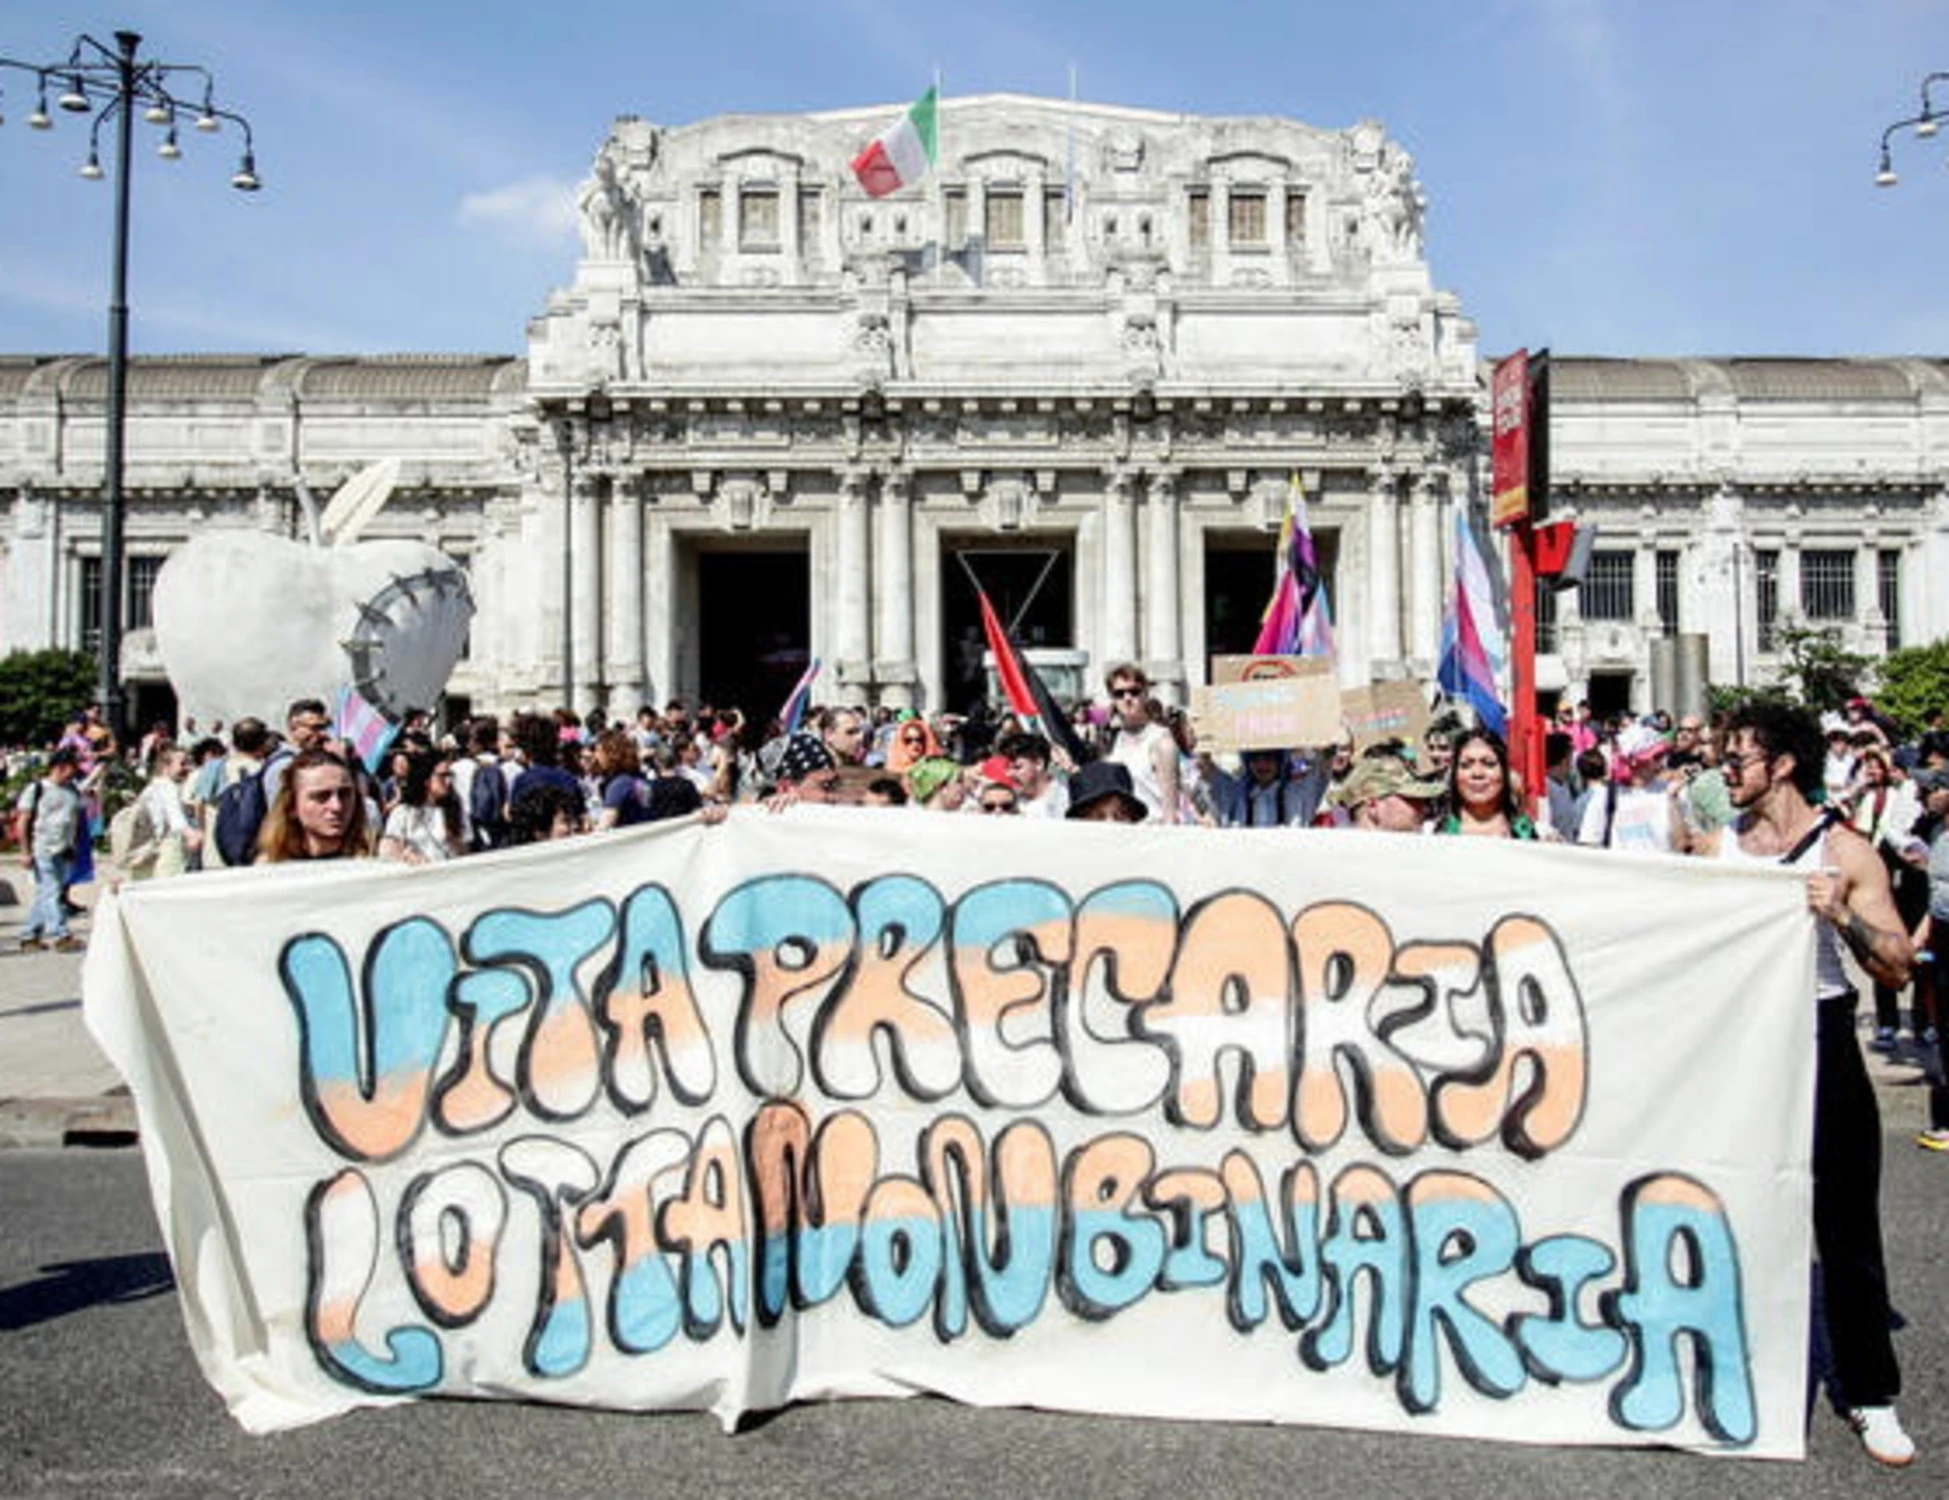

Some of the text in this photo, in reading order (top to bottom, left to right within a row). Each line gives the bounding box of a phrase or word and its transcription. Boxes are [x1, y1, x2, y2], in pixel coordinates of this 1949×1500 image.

[698, 871, 1590, 1161] PRECARIA
[305, 1113, 746, 1395] LOTTA
[1056, 1131, 1758, 1447] BINARIA
